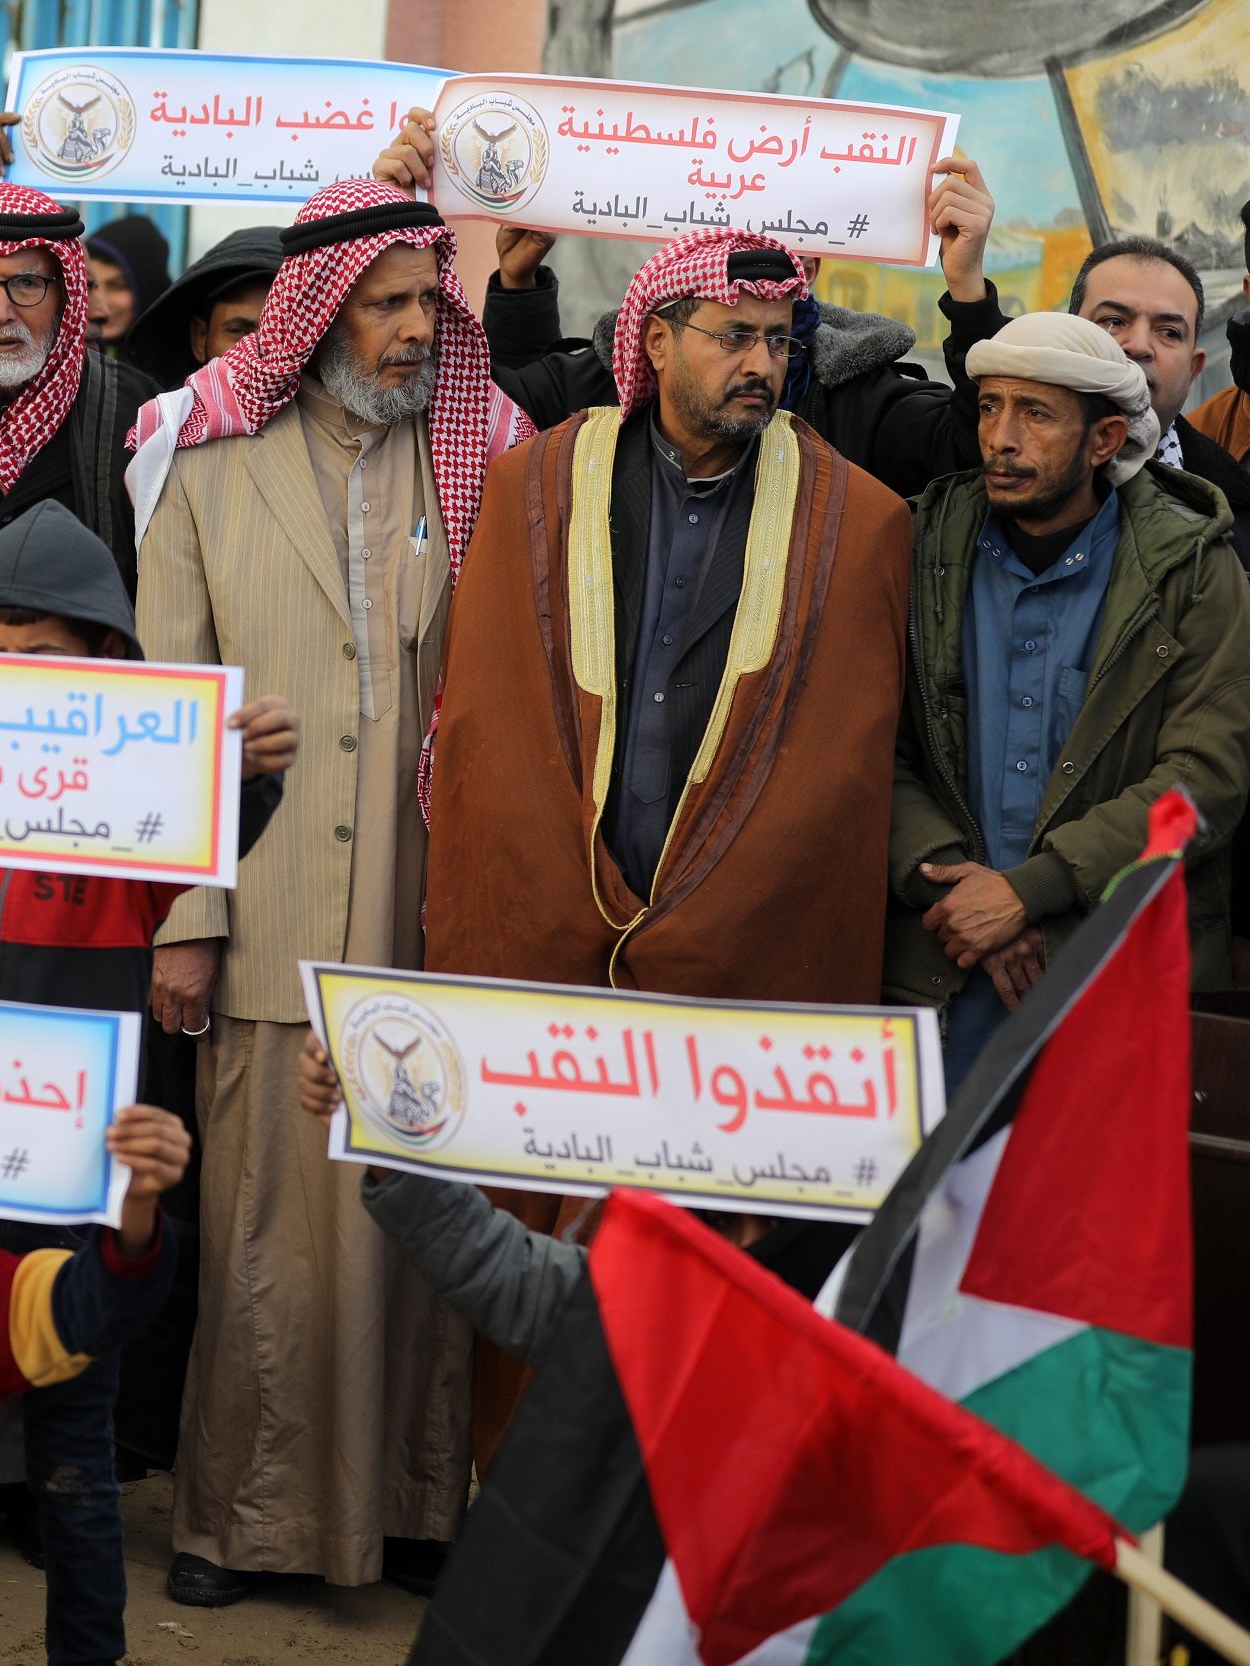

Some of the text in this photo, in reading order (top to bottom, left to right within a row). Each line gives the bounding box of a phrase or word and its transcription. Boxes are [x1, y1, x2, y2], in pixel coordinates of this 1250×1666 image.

[151, 92, 262, 138] البادية
[276, 100, 373, 140] غضب
[558, 107, 916, 173] النقب أرض فلسطينية
[688, 156, 765, 199] عربية
[18, 758, 89, 800] قرى
[482, 1018, 897, 1133] أنقذوا النقب
